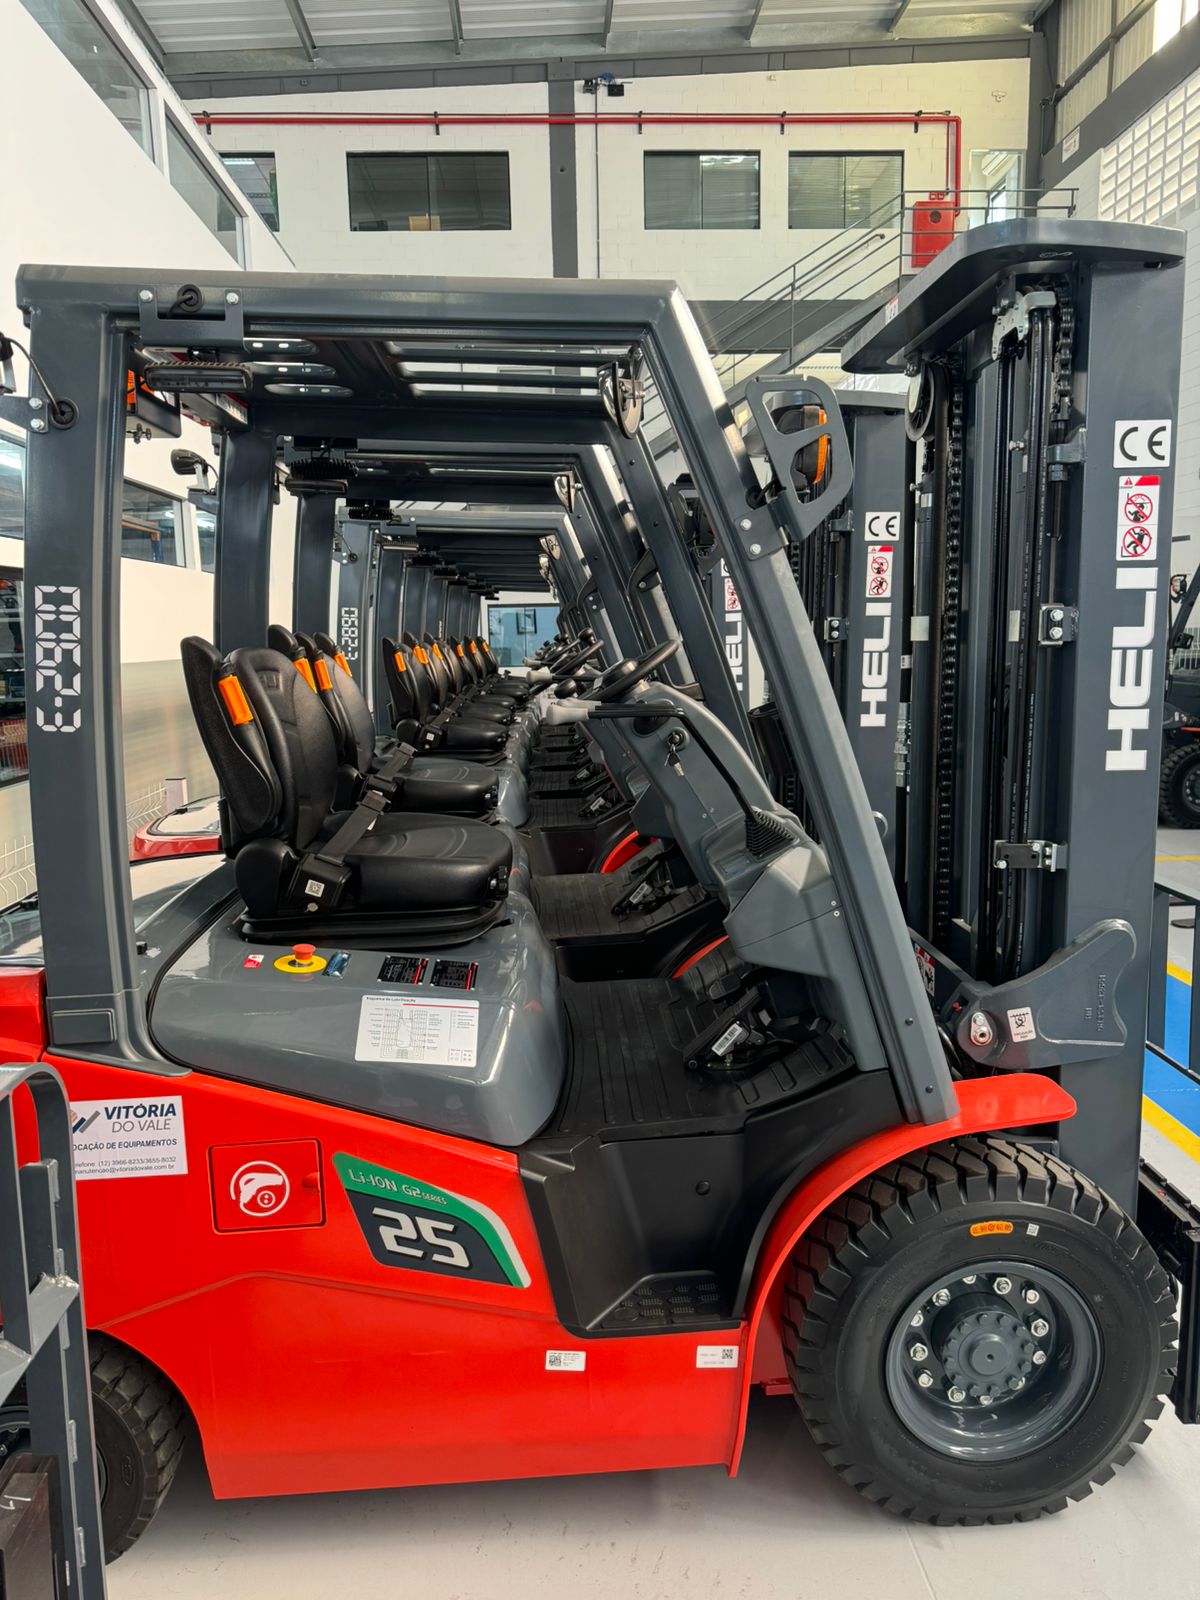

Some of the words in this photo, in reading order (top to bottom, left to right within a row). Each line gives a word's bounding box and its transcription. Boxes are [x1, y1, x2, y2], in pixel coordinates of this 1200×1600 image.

[1119, 425, 1167, 462] CE
[868, 515, 898, 537] CE
[34, 585, 82, 733] E-2900
[860, 602, 892, 727] HELI
[1105, 567, 1159, 771] HELI
[104, 1103, 177, 1120] VITÓRIA
[112, 1121, 135, 1133] DO
[138, 1119, 171, 1131] VALE
[73, 1141, 105, 1152] OCAÇÃO
[106, 1141, 117, 1150] DE
[118, 1138, 177, 1149] EQUIPAMENTOS
[402, 1184, 422, 1198] G2
[372, 1207, 470, 1268] 25
